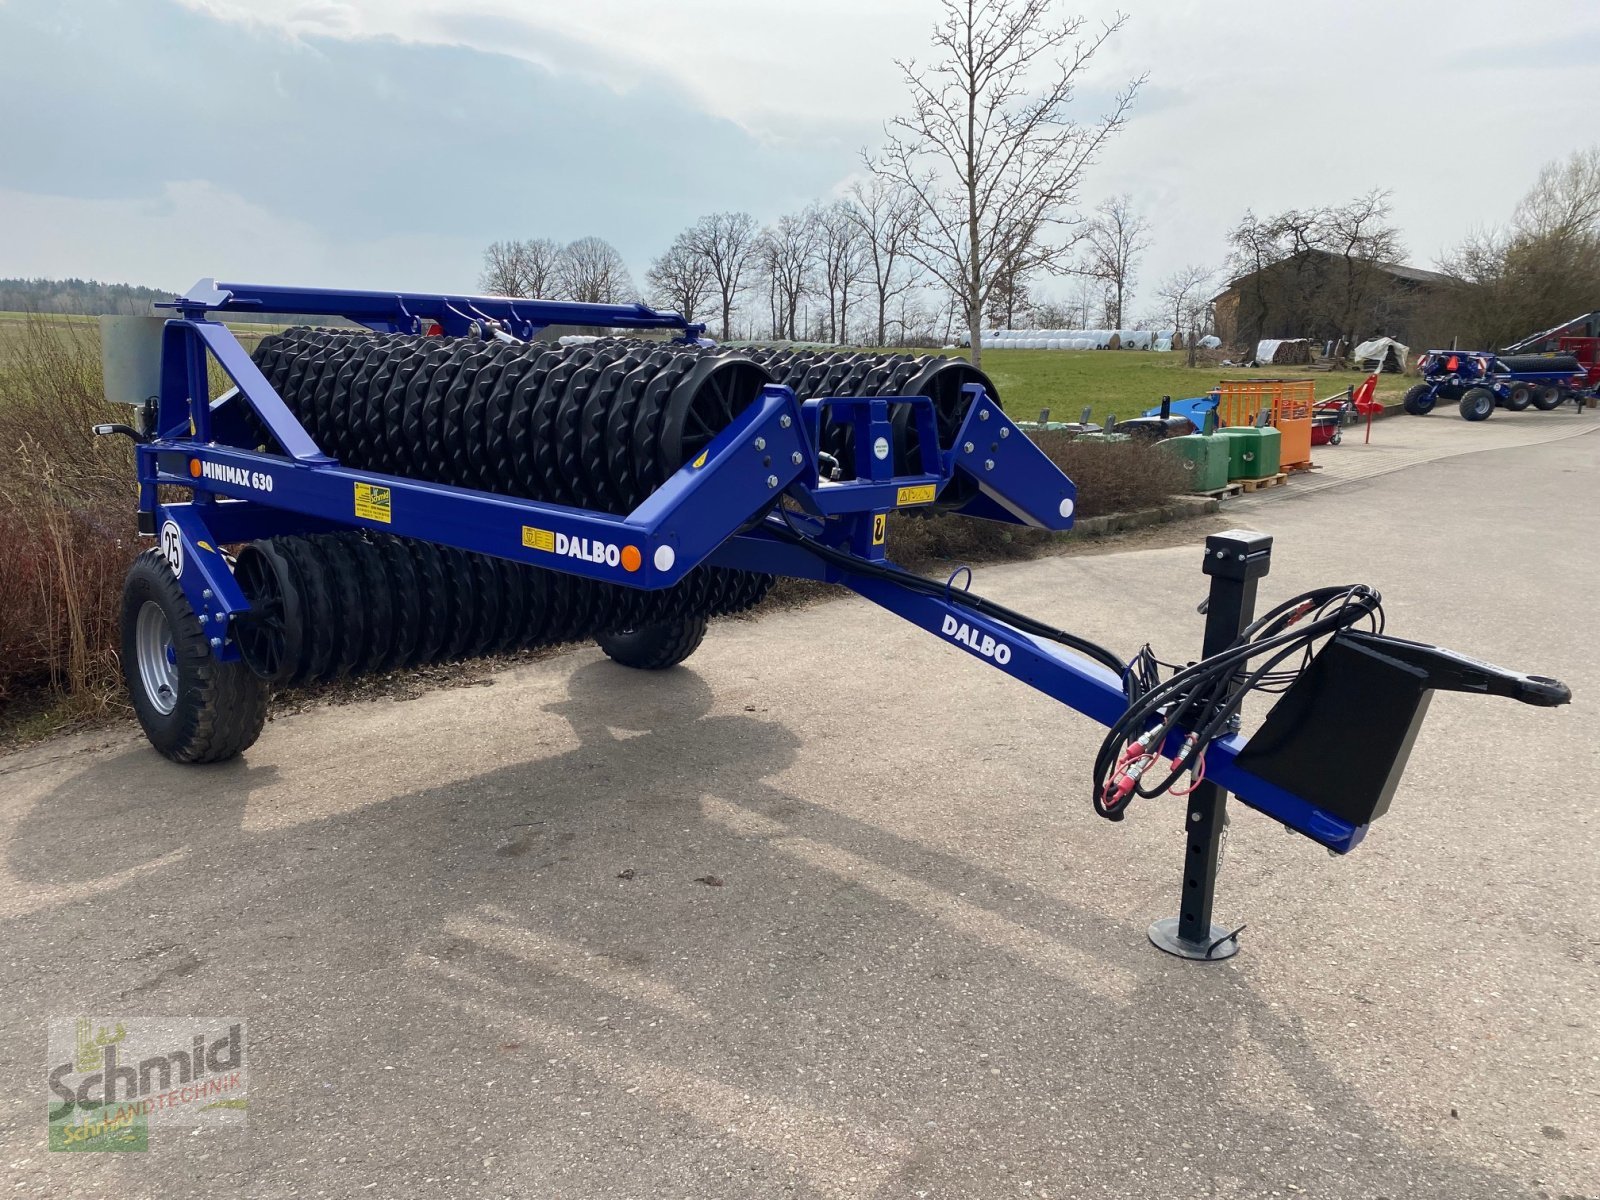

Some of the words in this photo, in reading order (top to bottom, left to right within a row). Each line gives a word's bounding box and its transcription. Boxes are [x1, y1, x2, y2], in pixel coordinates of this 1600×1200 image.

[202, 461, 250, 487] MINIMAX
[252, 472, 273, 492] 630
[165, 531, 179, 569] 25
[555, 532, 620, 567] DALBO
[941, 613, 1012, 665] DALBO
